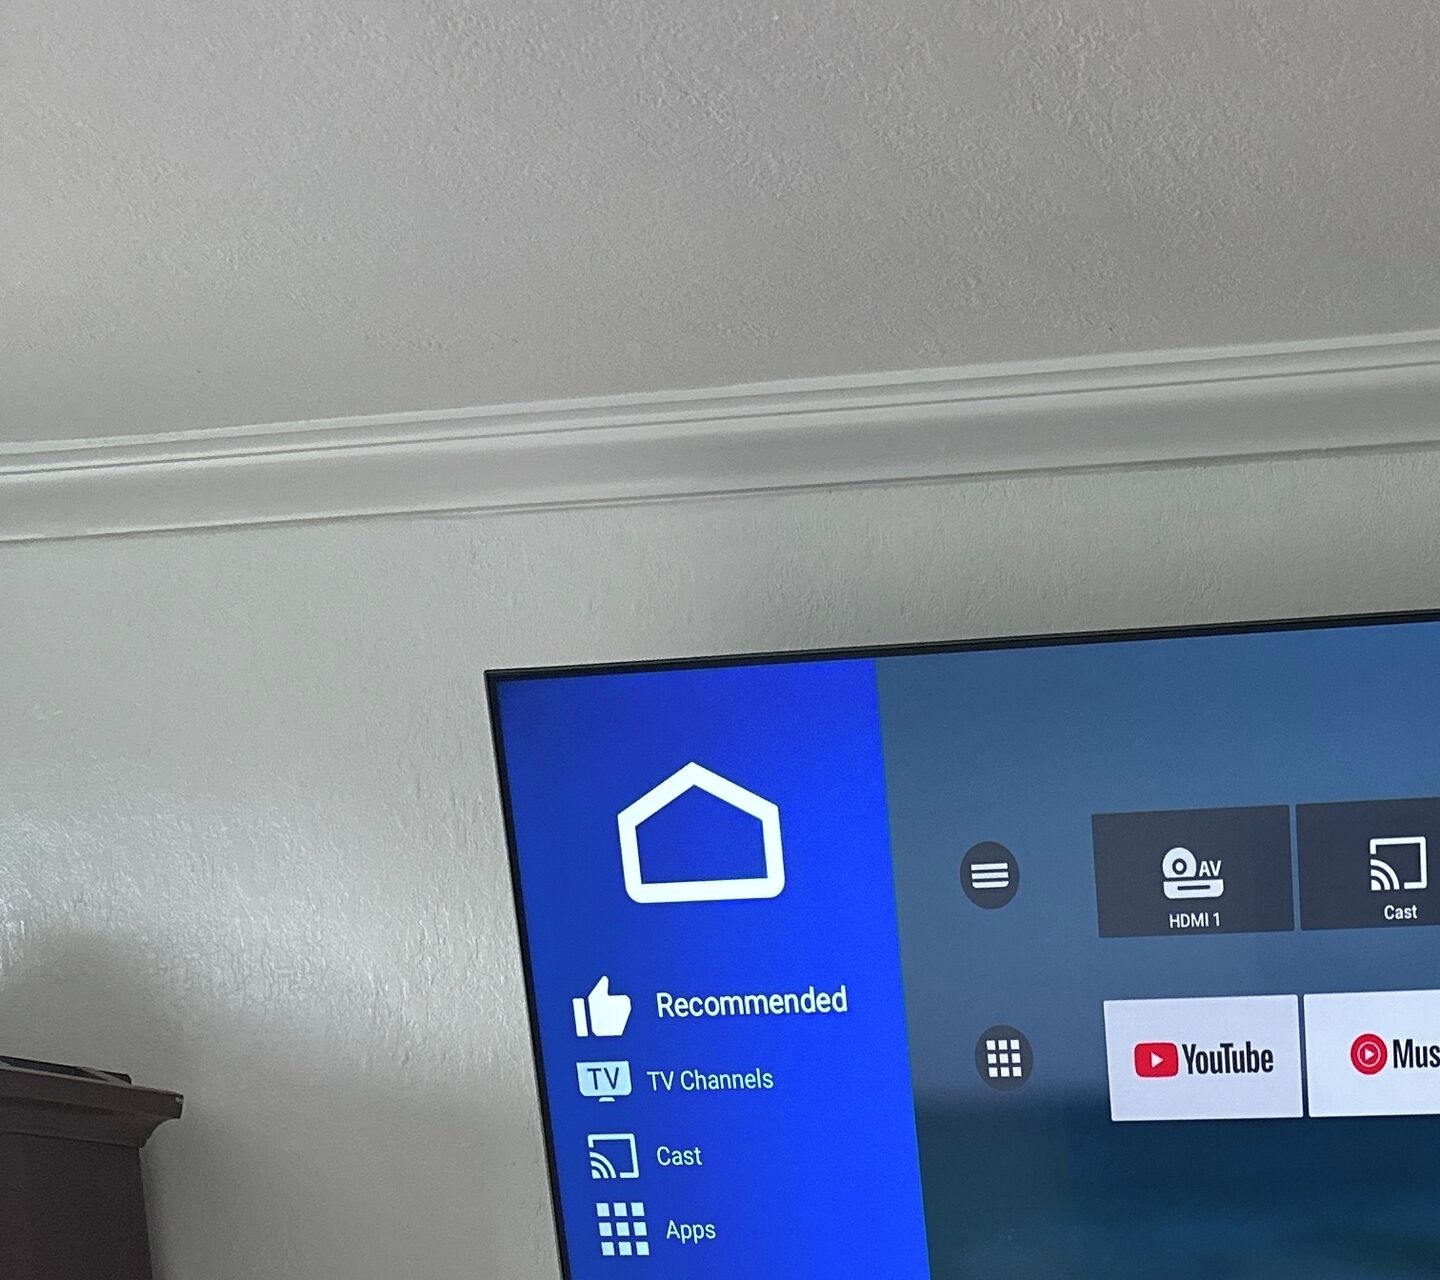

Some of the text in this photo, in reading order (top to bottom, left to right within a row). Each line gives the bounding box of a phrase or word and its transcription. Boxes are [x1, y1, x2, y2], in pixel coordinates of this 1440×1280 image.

[1199, 860, 1222, 877] AV
[1169, 912, 1220, 929] HDMI 1
[1384, 904, 1418, 920] Cast
[656, 984, 849, 1019] Recommended
[1181, 1040, 1274, 1075] YouTube
[587, 1067, 620, 1090] TV
[646, 1067, 775, 1092] TV Channels
[656, 1146, 703, 1167] Cast
[666, 1219, 717, 1245] Apps
